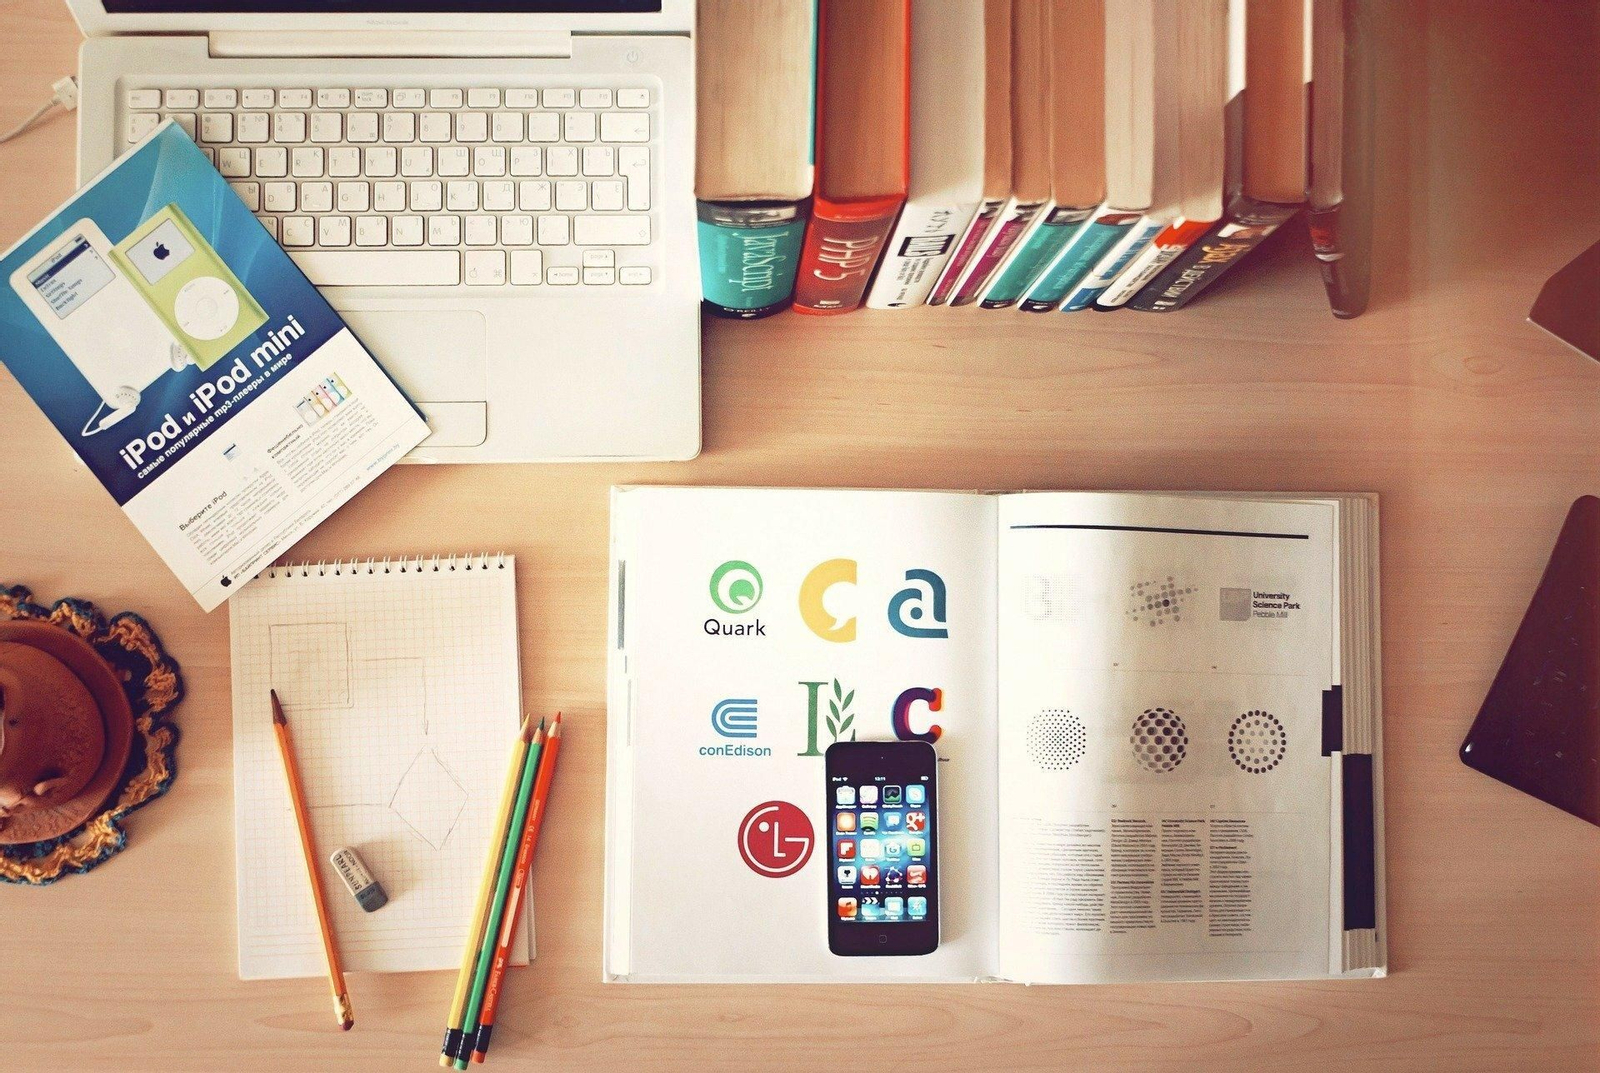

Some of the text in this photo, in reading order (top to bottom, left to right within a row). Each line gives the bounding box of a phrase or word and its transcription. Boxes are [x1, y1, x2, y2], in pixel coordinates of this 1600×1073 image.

[729, 231, 790, 292] JavaScript
[118, 314, 306, 470] iPod и iPod mini
[136, 454, 166, 479] самые
[164, 414, 216, 458] популярные
[213, 375, 265, 419] mp3-плееры
[269, 352, 293, 373] мире
[178, 490, 227, 531] Выберите iPod
[1253, 592, 1290, 600] University
[1253, 601, 1282, 609] Science
[704, 619, 766, 636] Quark
[699, 744, 771, 757] conEdison
